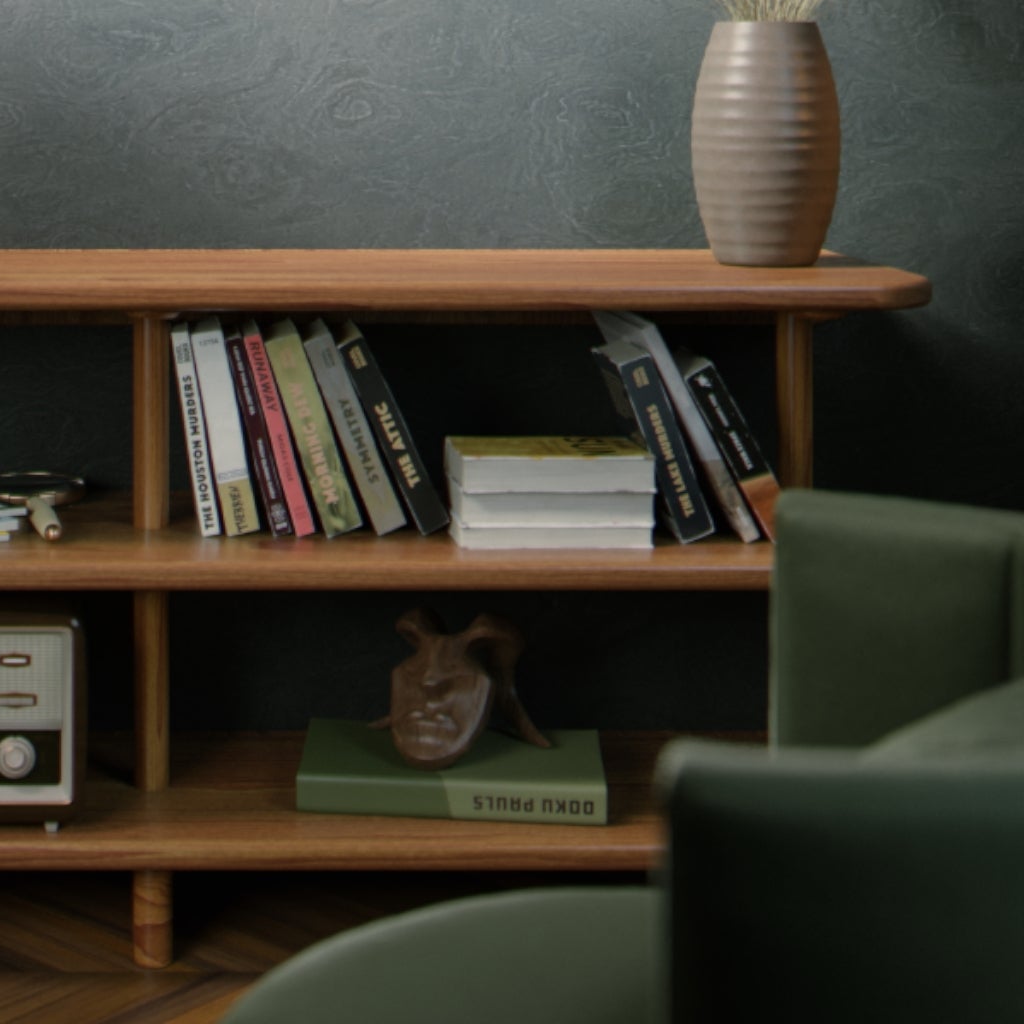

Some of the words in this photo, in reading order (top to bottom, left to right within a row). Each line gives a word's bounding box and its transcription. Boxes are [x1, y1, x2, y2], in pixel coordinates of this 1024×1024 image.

[248, 340, 278, 413] RUNAWAY
[182, 374, 201, 436] MURDERS
[287, 382, 311, 419] DEW
[338, 397, 380, 484] SYMMETRY
[373, 401, 406, 451] ATTIC
[645, 403, 676, 461] MURDERS
[191, 439, 210, 502] HOUSTON
[301, 421, 340, 504] MORNING
[397, 453, 422, 488] THE
[667, 461, 687, 493] LAKE
[201, 505, 215, 529] THE
[678, 492, 696, 518] THE
[472, 796, 533, 812] PAULS
[541, 799, 594, 815] DOKU
